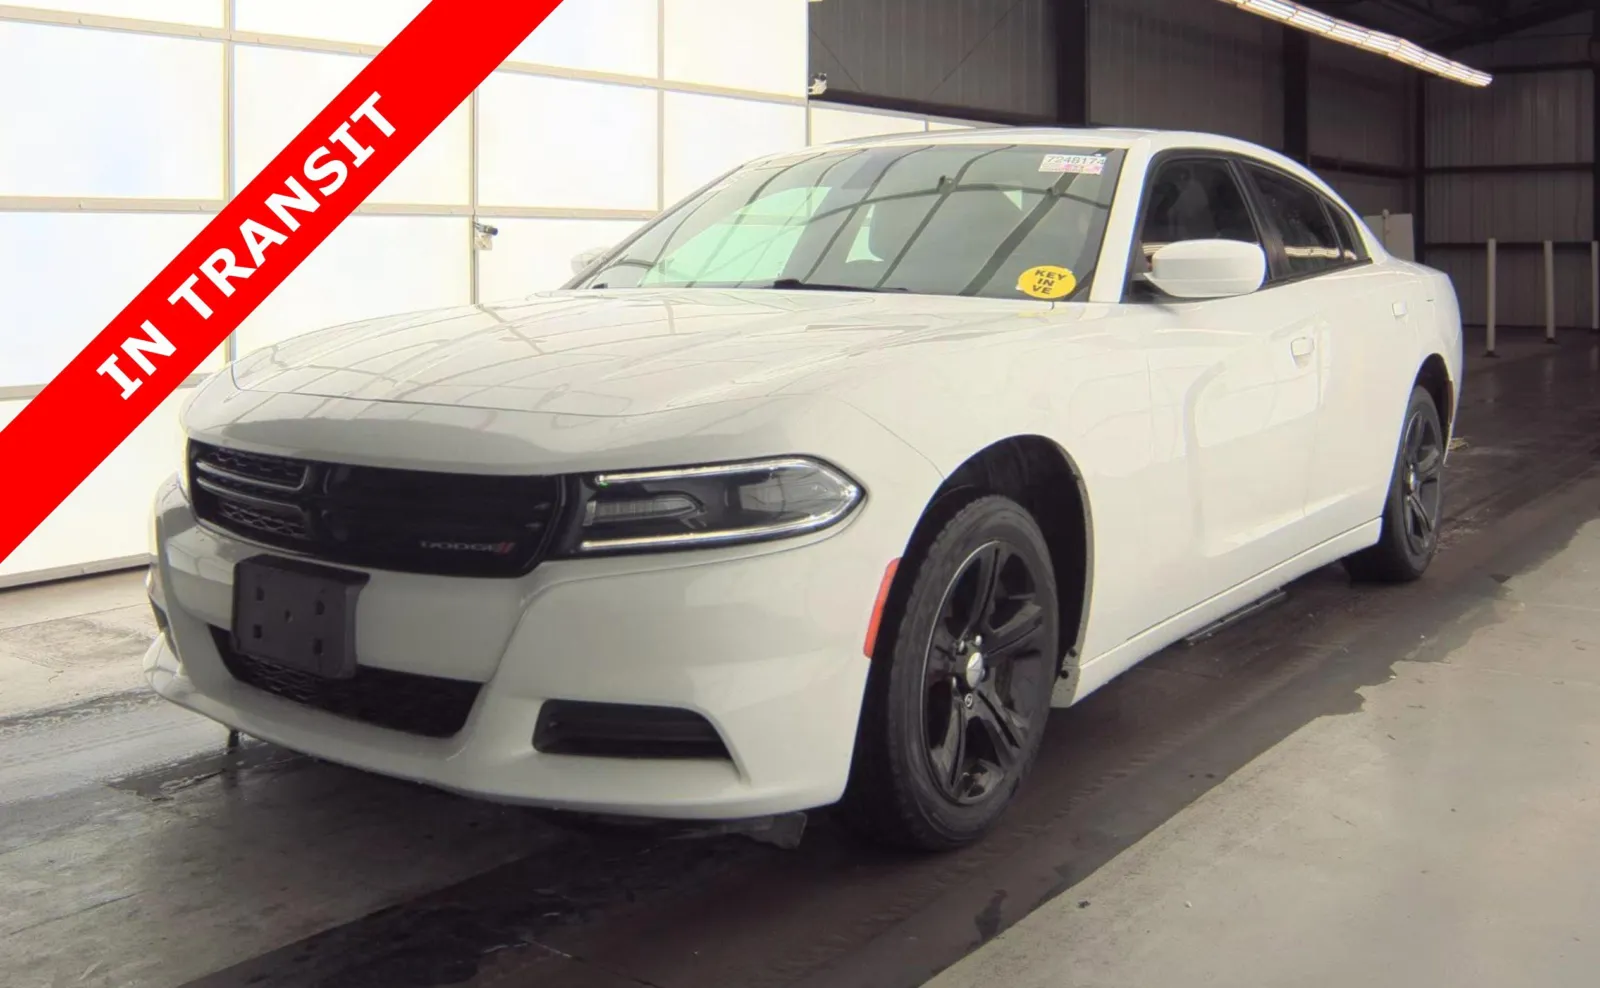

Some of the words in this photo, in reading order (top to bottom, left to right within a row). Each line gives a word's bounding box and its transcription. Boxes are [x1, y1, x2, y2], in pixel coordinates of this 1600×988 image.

[1034, 269, 1067, 281] KEY
[1037, 278, 1055, 287] IN
[419, 540, 500, 553] DODGE
